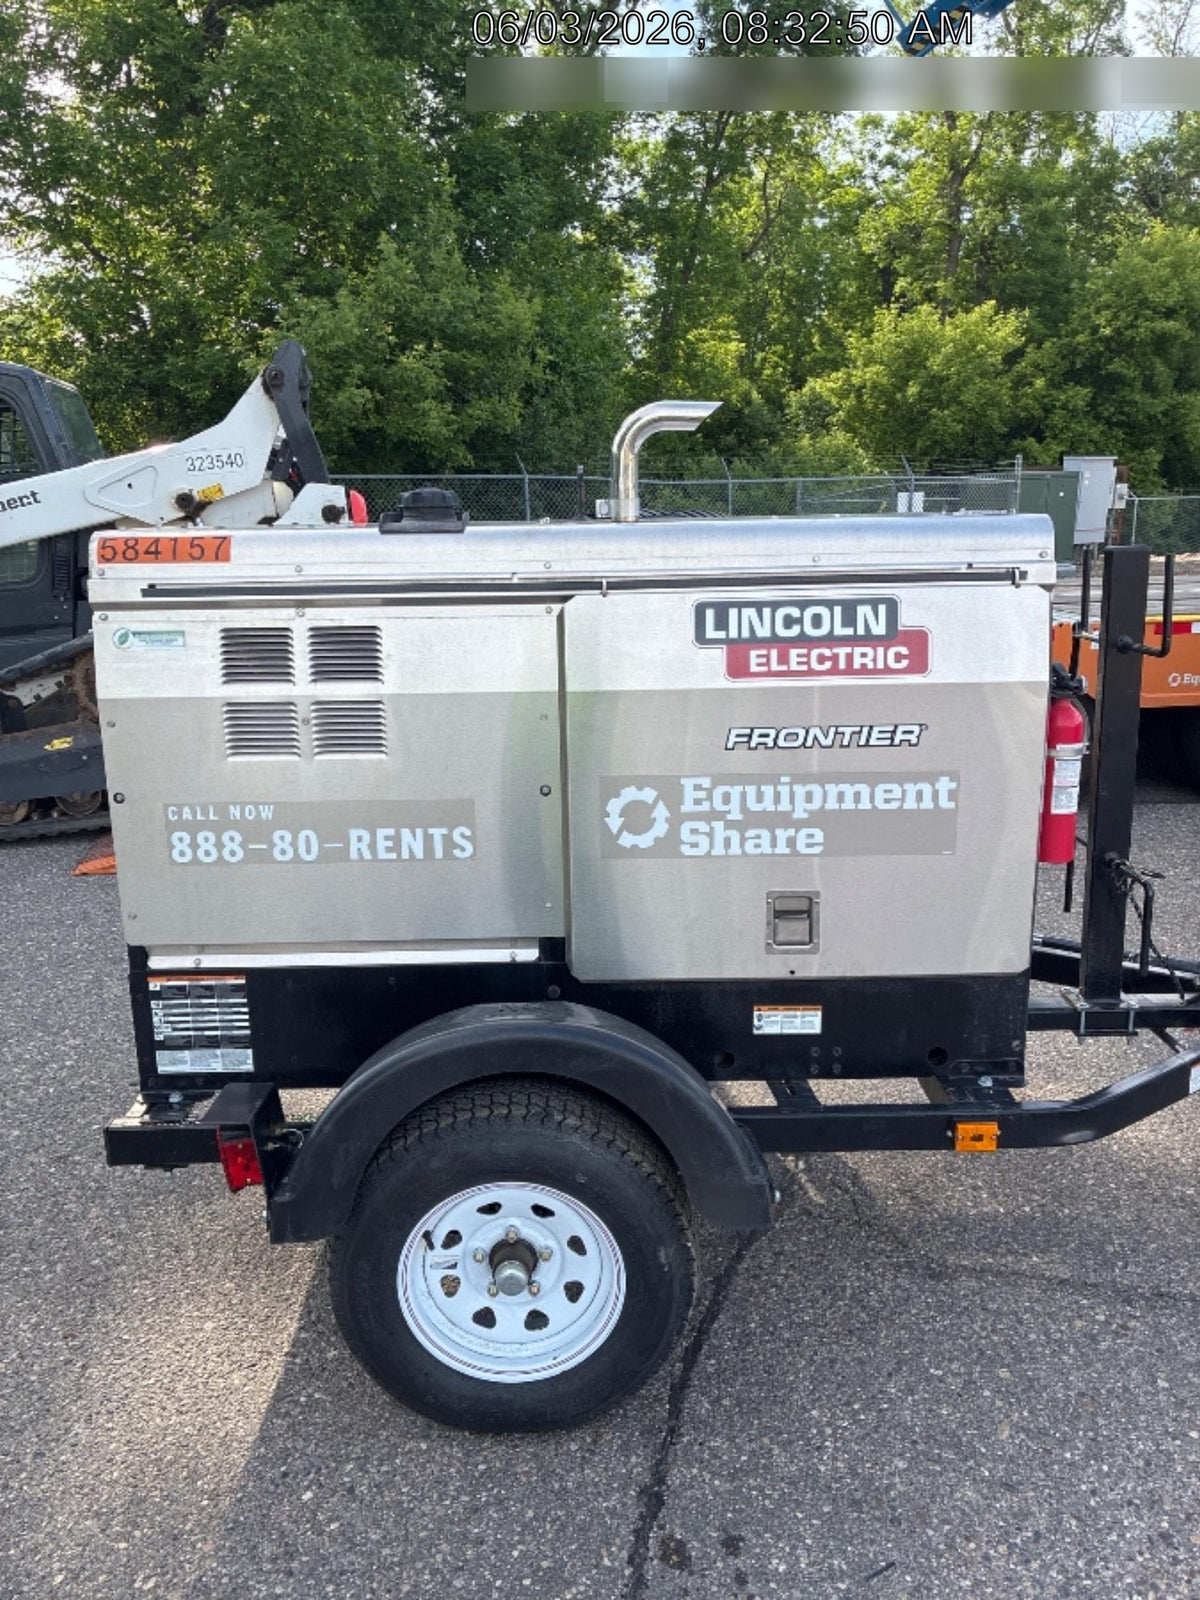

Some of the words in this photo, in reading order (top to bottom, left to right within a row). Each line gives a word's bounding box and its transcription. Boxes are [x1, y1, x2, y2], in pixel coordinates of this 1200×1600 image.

[186, 452, 244, 471] 323540
[100, 536, 229, 562] 584157
[705, 603, 887, 639] LINCOLN
[749, 646, 909, 673] ELECTRIC
[725, 724, 925, 751] FRONTIER
[680, 776, 957, 820] Equipment
[167, 805, 219, 821] CALL
[229, 804, 275, 820] NOW
[680, 820, 824, 856] Share
